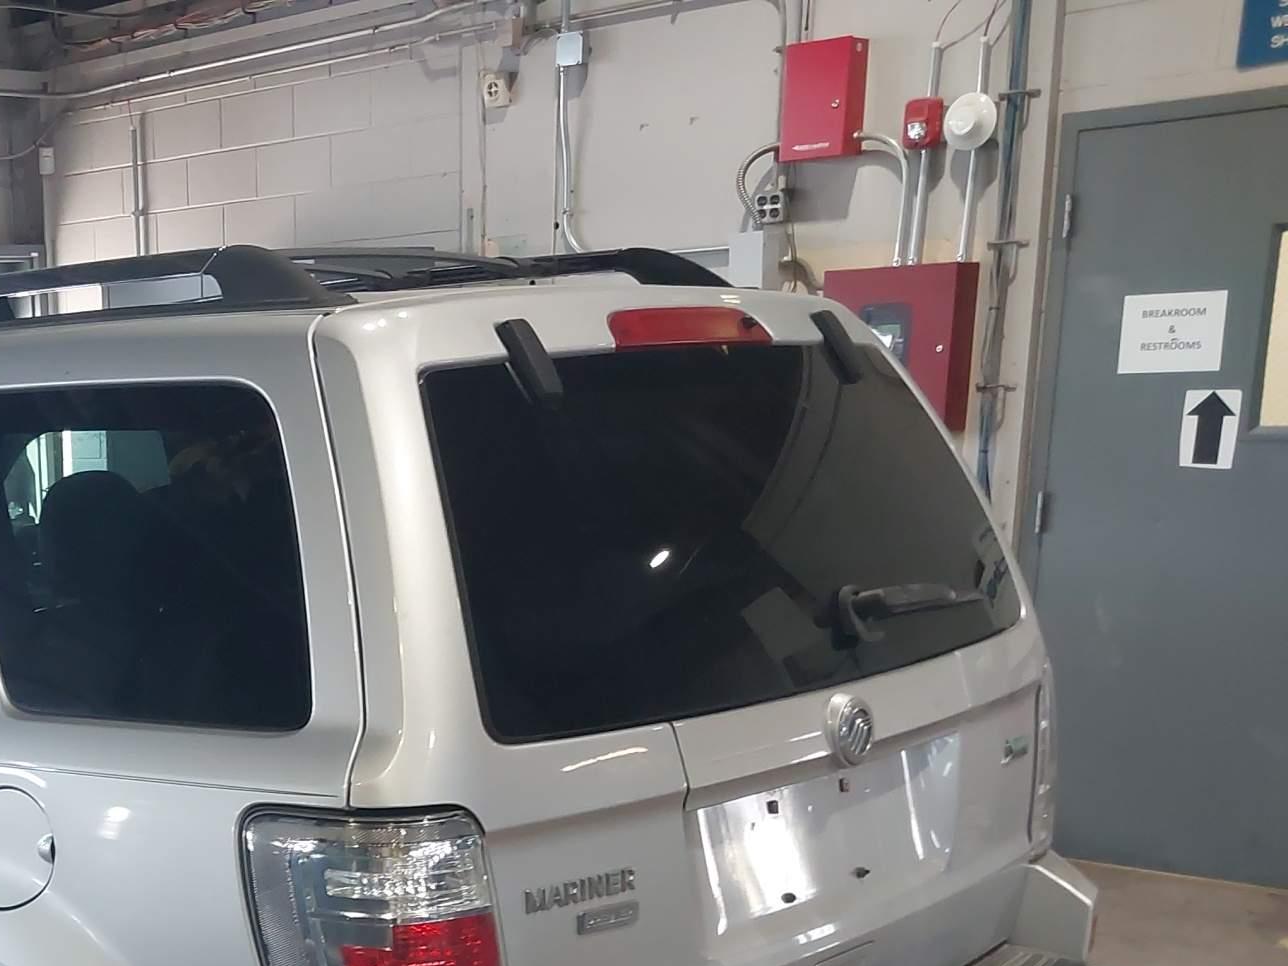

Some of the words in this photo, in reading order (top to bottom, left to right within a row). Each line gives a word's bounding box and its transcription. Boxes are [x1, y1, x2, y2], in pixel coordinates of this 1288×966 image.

[1142, 307, 1207, 319] BREAKROOM
[1168, 325, 1176, 334] &
[1140, 341, 1202, 351] RESTROOMS
[524, 867, 636, 914] MARINER
